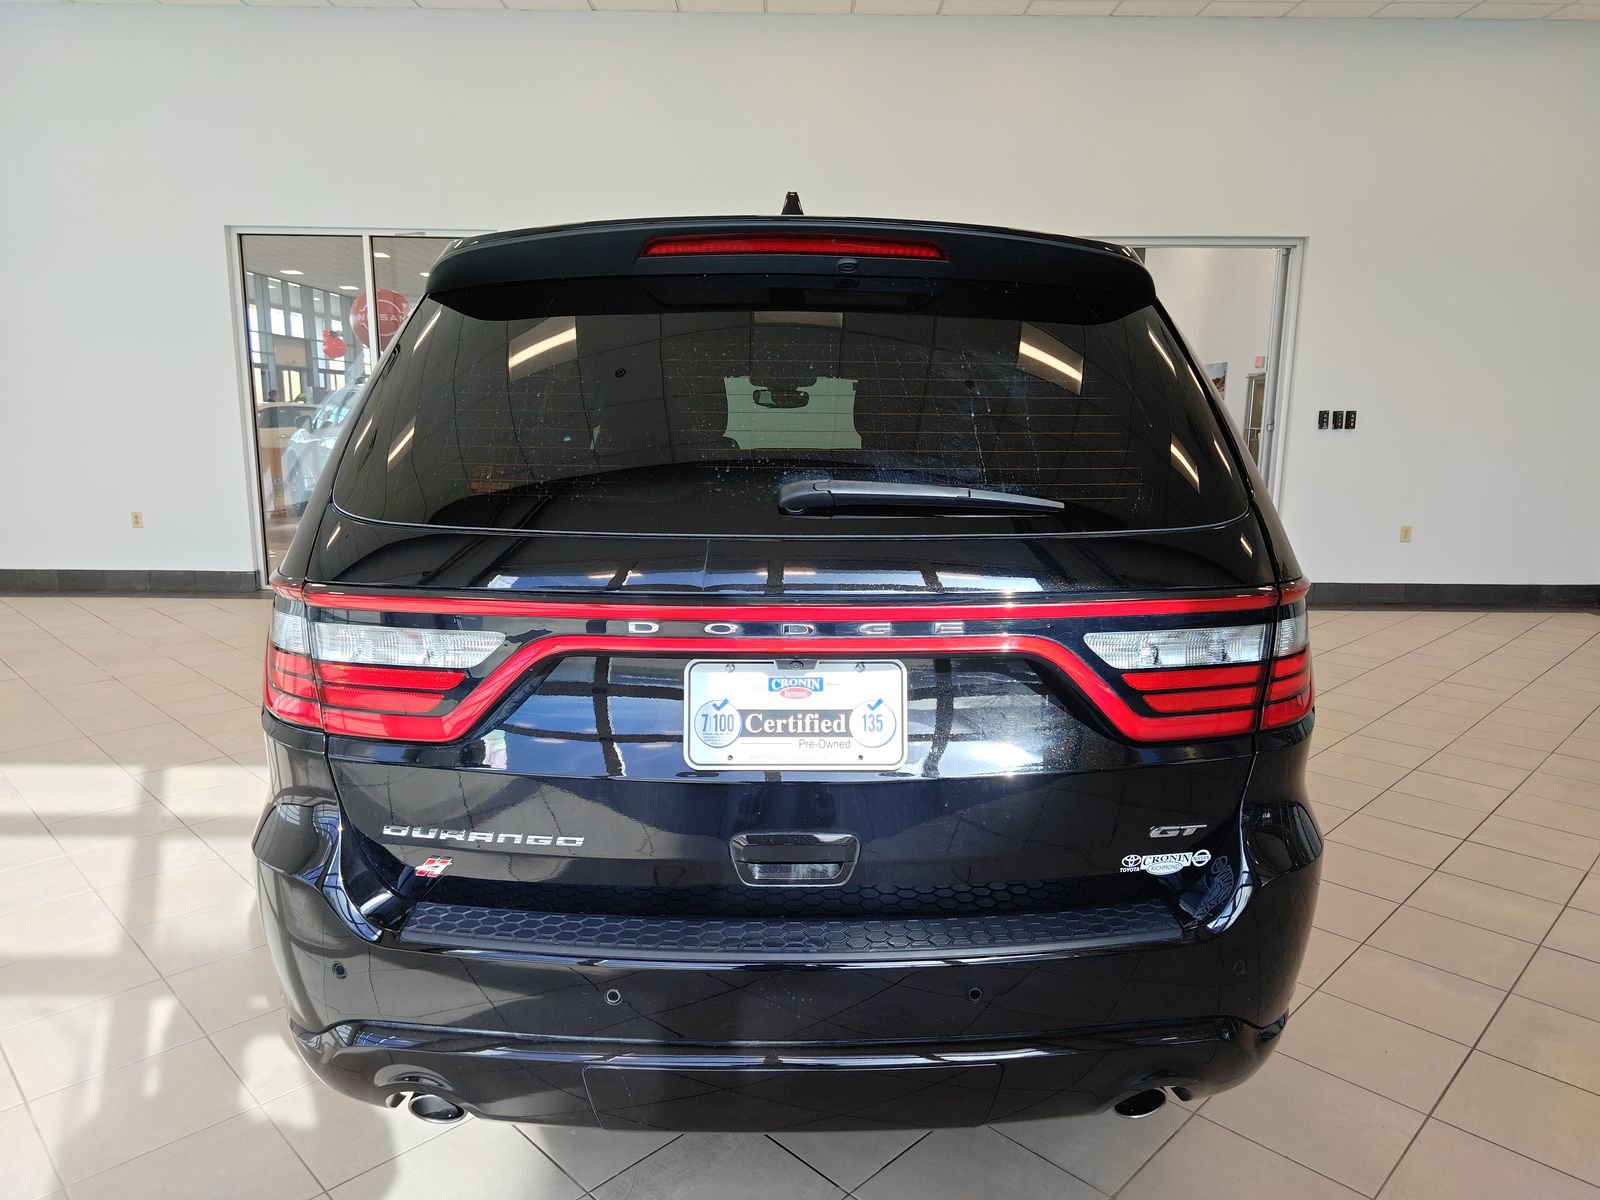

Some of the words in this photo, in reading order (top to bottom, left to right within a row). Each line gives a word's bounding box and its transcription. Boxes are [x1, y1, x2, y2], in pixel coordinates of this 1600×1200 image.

[627, 620, 965, 635] DODGE
[771, 678, 821, 691] CRONIN
[745, 713, 847, 734] Certified
[862, 713, 884, 732] 135
[798, 738, 851, 749] Pre-Owned
[382, 824, 585, 847] DURANGO
[1149, 824, 1208, 839] GT
[1143, 854, 1191, 866] CRONIN
[1150, 863, 1181, 872] RICHMOND
